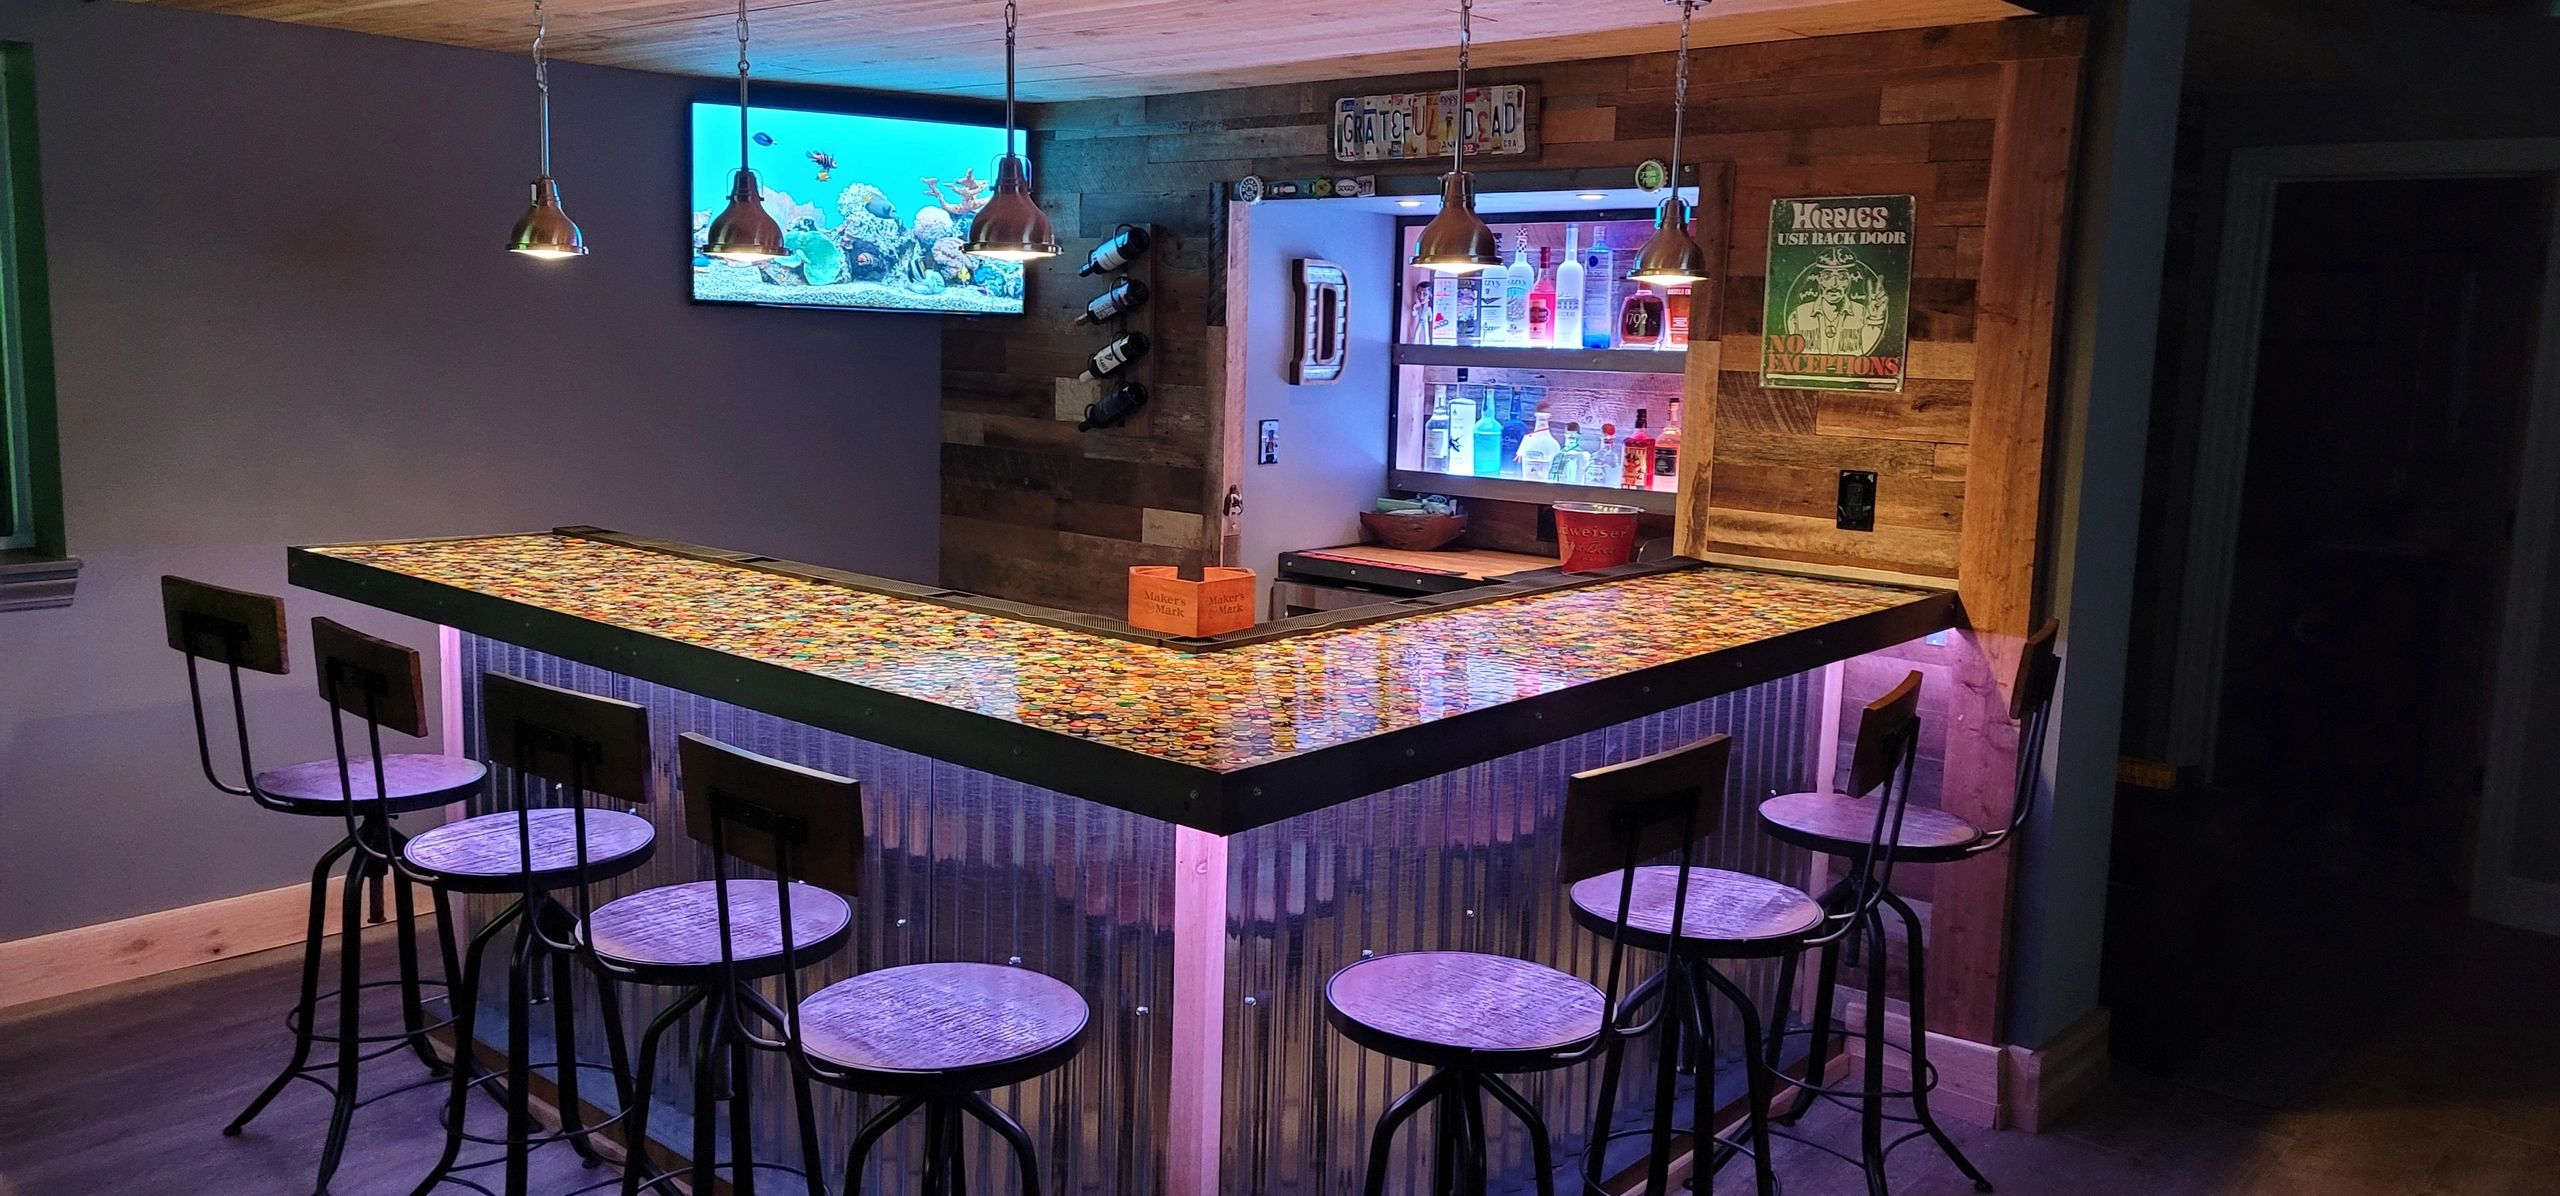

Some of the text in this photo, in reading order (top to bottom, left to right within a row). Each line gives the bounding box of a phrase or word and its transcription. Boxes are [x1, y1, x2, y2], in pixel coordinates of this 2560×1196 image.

[1343, 102, 1516, 145] GRATEFUL DEAD
[1792, 203, 1889, 229] HIPPIES
[1778, 231, 1907, 245] USE BACK DOOR
[1626, 313, 1648, 328] 1792
[1769, 334, 1805, 354] NO
[1767, 352, 1900, 376] EXCEPTIONS
[1143, 590, 1187, 607] Maker's
[1208, 592, 1245, 606] Maker's
[1155, 604, 1185, 618] Mark
[1218, 603, 1244, 615] Mark
